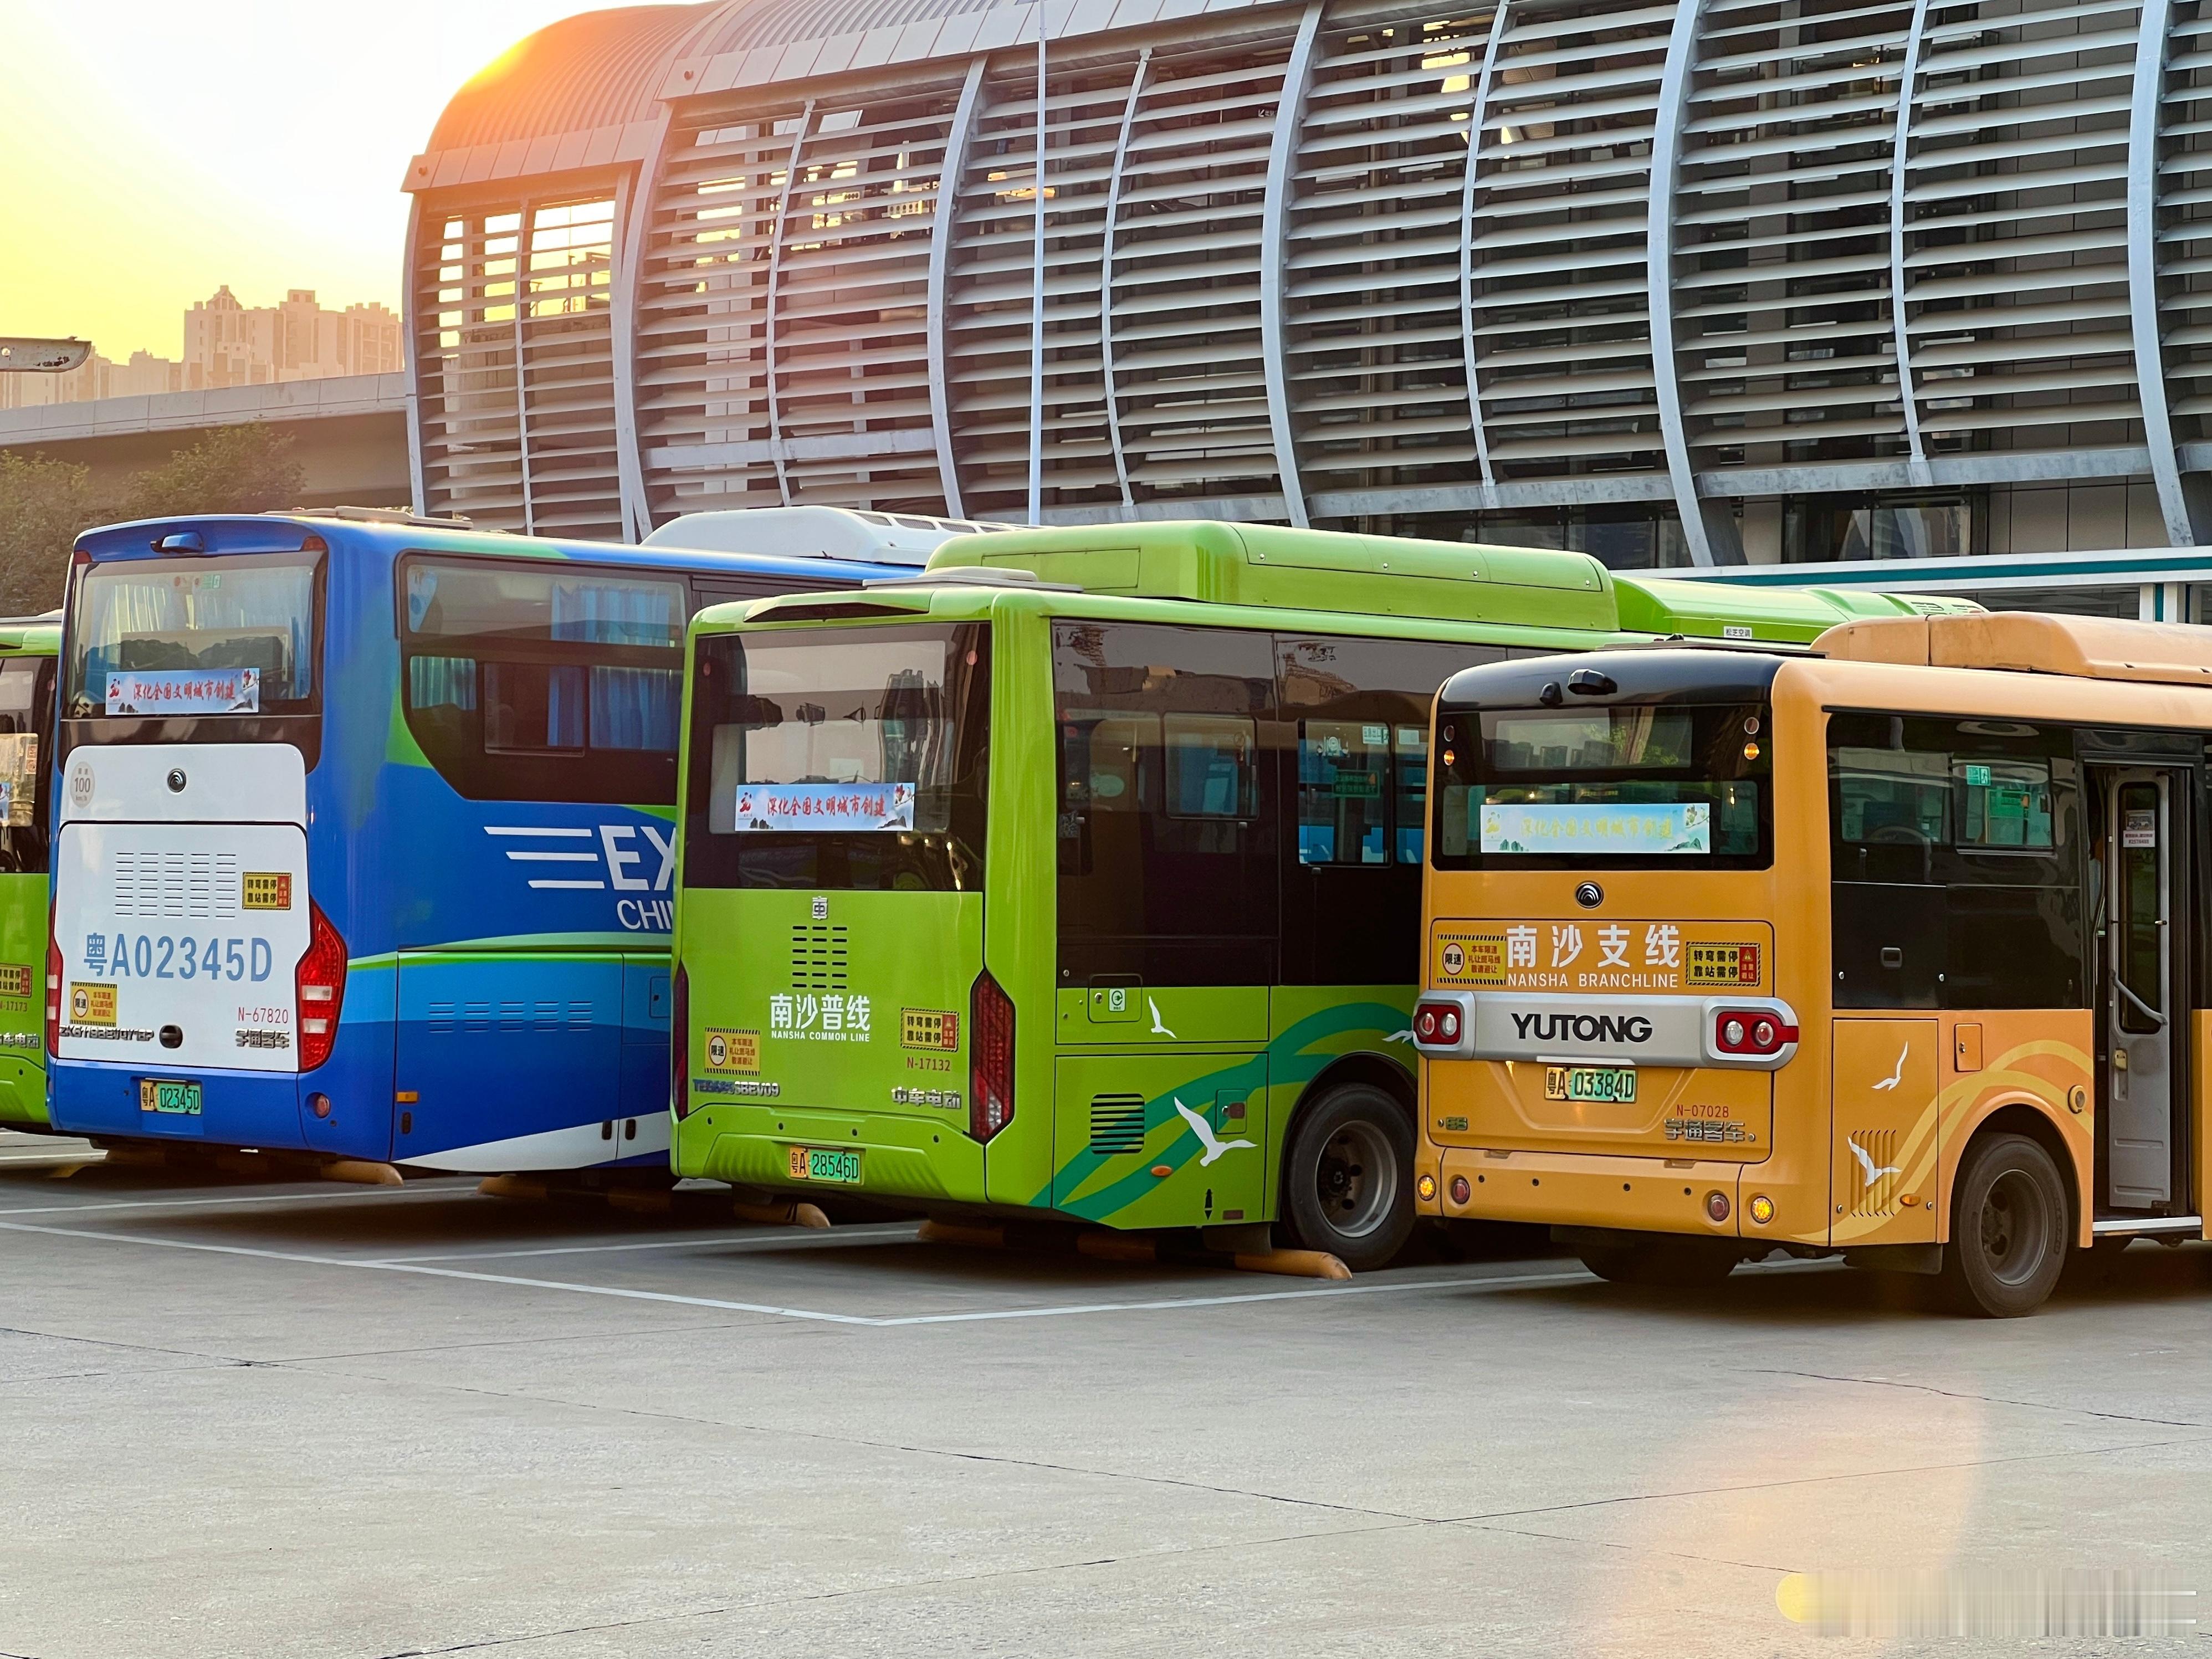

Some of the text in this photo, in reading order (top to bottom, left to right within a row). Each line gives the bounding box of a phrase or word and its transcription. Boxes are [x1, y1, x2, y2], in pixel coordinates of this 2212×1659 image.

[75, 777, 90, 792] 100
[767, 793, 887, 817] 深化全国文明城市创建
[599, 826, 677, 891] EX
[1507, 924, 1680, 967] 南沙支线
[84, 932, 272, 982] 粤A02345D
[1445, 953, 1462, 965] 限速
[1694, 950, 1738, 962] 转弯需停
[1694, 965, 1738, 978] 靠站需停
[1508, 973, 1678, 988] NANSHA BRANCHLINE
[238, 1007, 288, 1023] N-67820
[770, 993, 871, 1031] 南沙普线
[1510, 1013, 1653, 1043] YUTONG
[235, 1028, 289, 1049] 宇通客车
[771, 1031, 870, 1042] NANSHA COMMON LINE
[711, 1045, 724, 1056] 限速
[907, 1057, 950, 1071] N-17132
[891, 1086, 961, 1109] 中车电动
[1677, 1104, 1729, 1118] N-07028
[1664, 1118, 1745, 1143] 宇通客车
